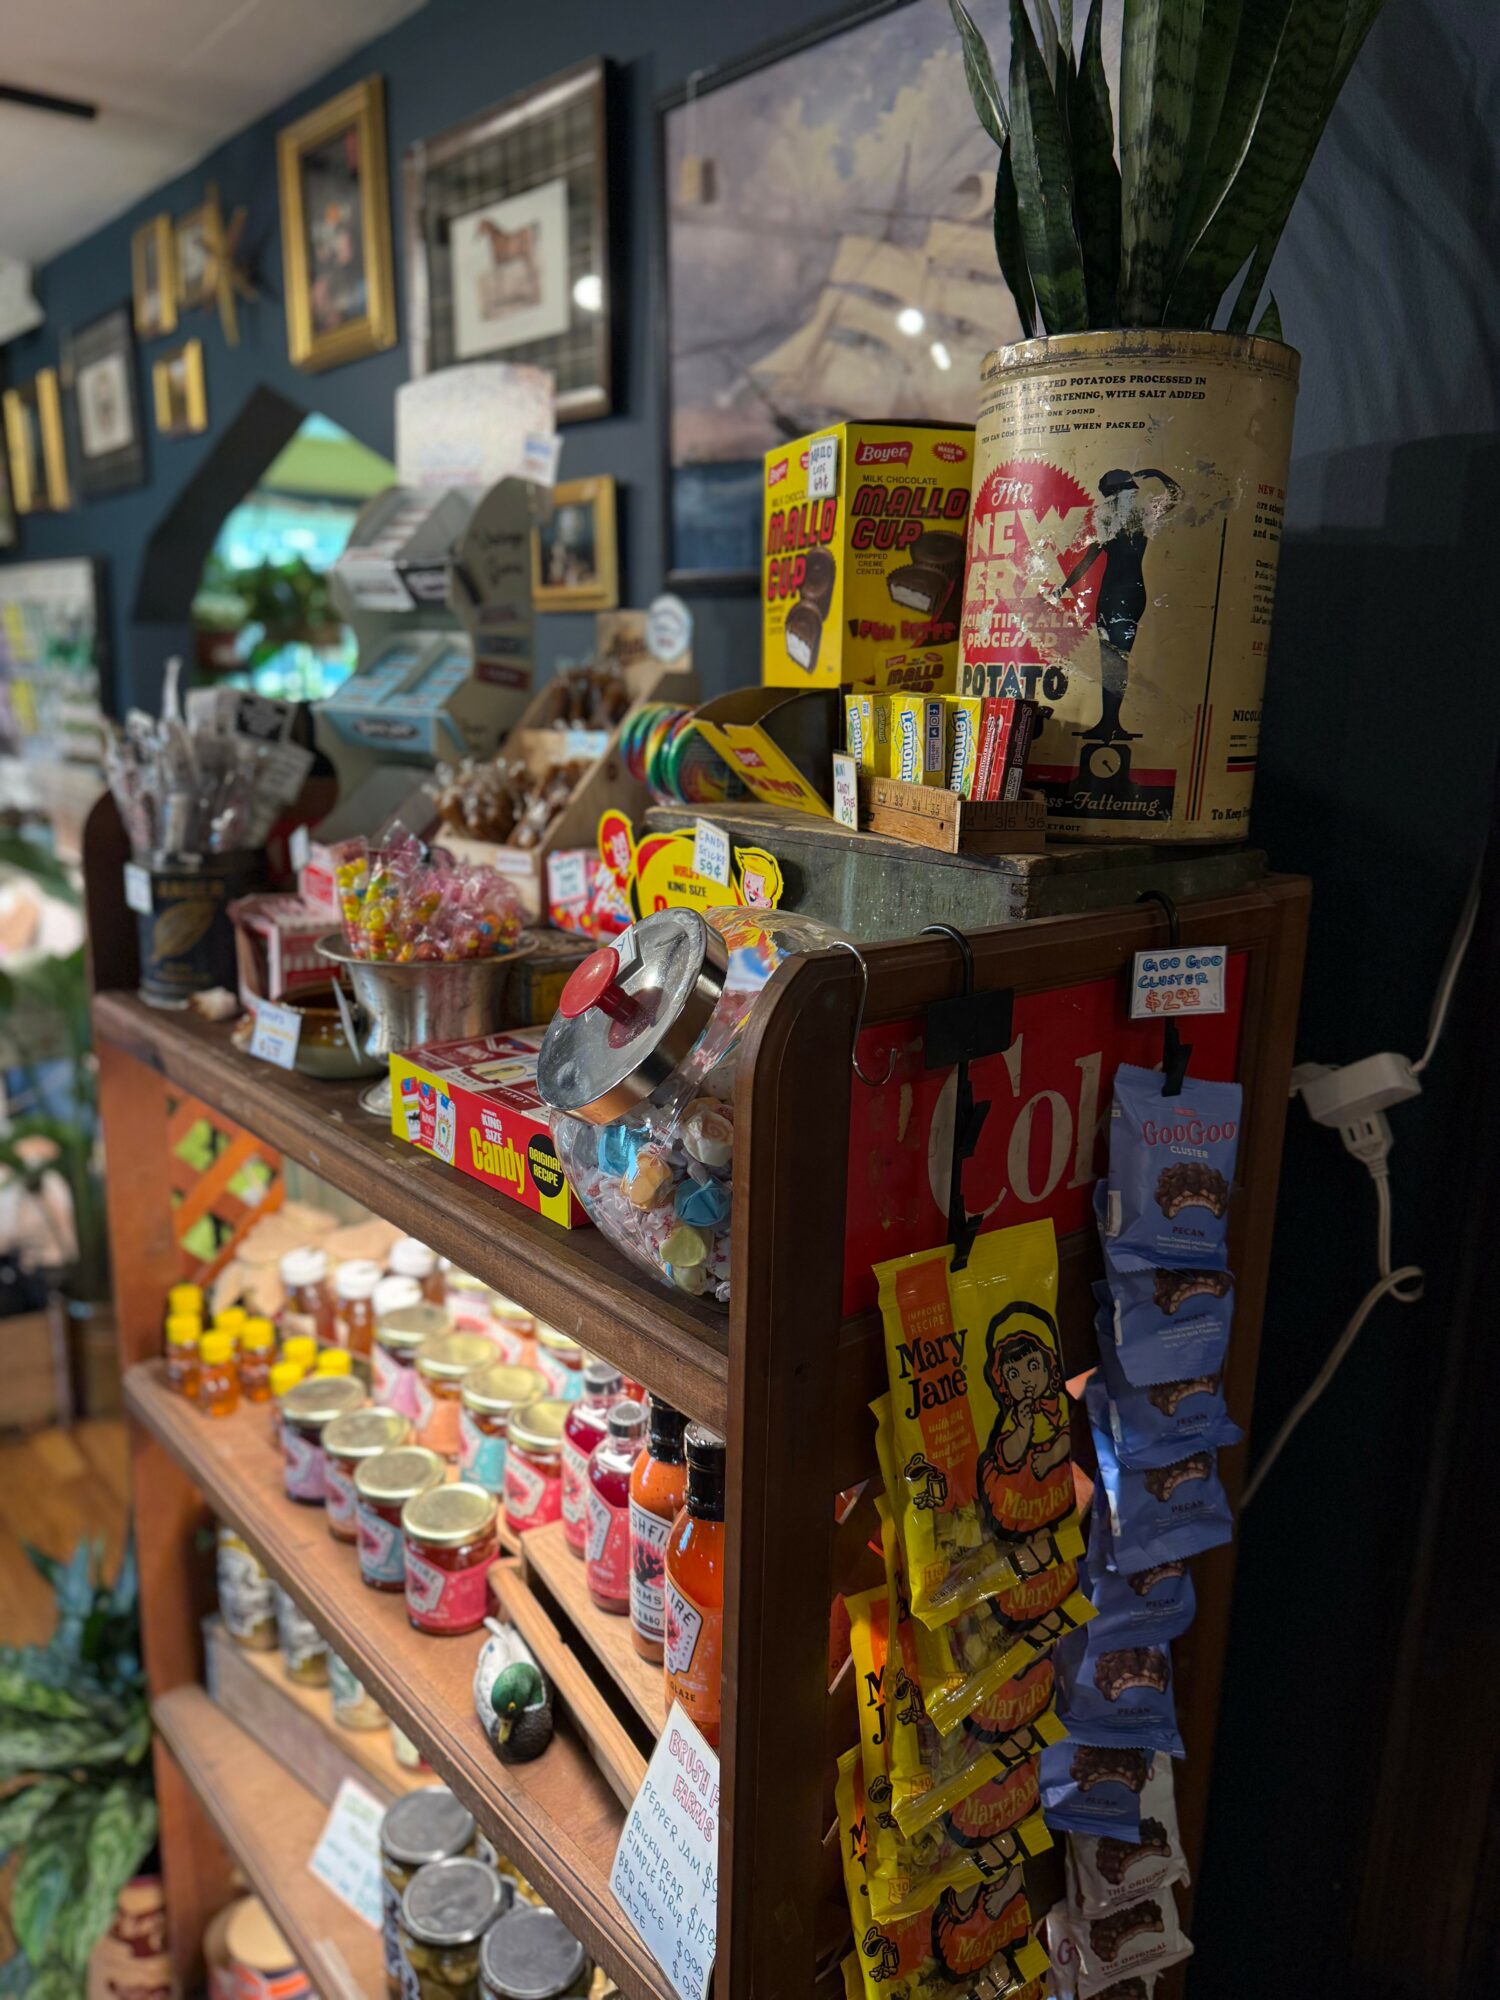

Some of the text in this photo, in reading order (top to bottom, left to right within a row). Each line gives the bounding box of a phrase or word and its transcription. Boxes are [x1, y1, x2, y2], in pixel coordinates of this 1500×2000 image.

[1070, 375, 1126, 386] POTATOES
[1130, 374, 1193, 384] PROCESSED
[1195, 377, 1207, 385] IN
[1106, 390, 1136, 399] WITH
[1139, 390, 1166, 399] SALT
[1169, 390, 1206, 400] ADDED
[1047, 409, 1065, 417] ONE
[1050, 424, 1071, 433] FULL
[1073, 422, 1102, 430] WHEN
[1106, 421, 1146, 429] PACKED
[860, 445, 905, 462] Boyer
[863, 475, 938, 486] MILK CHOCOLATE
[851, 484, 971, 520] MALLO
[991, 477, 1034, 507] The
[767, 497, 838, 556] MALLO
[851, 518, 925, 551] CUP
[971, 505, 1091, 558] NEW
[1253, 529, 1267, 539] and
[767, 552, 808, 601] CUP
[963, 663, 1069, 701] POTATO
[1233, 709, 1261, 722] NICOL
[1028, 817, 1046, 828] 36
[1211, 808, 1223, 820] To
[700, 858, 721, 878] 59¢
[667, 881, 707, 897] KING SIZE
[1137, 972, 1209, 989] CLUSTER
[499, 1090, 530, 1105] CANDY
[481, 1113, 502, 1131] KING
[485, 1128, 503, 1146] SIZE
[469, 1127, 525, 1194] Candy
[529, 1146, 562, 1173] ORIGINAL
[1170, 1145, 1209, 1158] CLUSTER
[533, 1164, 559, 1187] RECIPE
[1172, 1226, 1205, 1237] PECAN
[907, 1302, 947, 1320] IMPROVED
[896, 1328, 968, 1379] Mary
[905, 1369, 968, 1420] Jane
[670, 1681, 696, 1703] GLAZE
[668, 1729, 711, 1797] BRUSH
[672, 1774, 716, 1843] FARMS
[643, 1781, 701, 1876] PEPPER JAM
[631, 1810, 684, 1903] PRICKLY PEAR
[618, 1850, 636, 1886] BBQ
[638, 1881, 665, 1931] SAUCE
[626, 1830, 657, 1885] SIMPLE
[658, 1878, 683, 1930] SYRUP
[614, 1874, 647, 1930] GLAZE
[1106, 1886, 1126, 1897] THE
[1101, 1942, 1167, 1972] THE ORIGINAL
